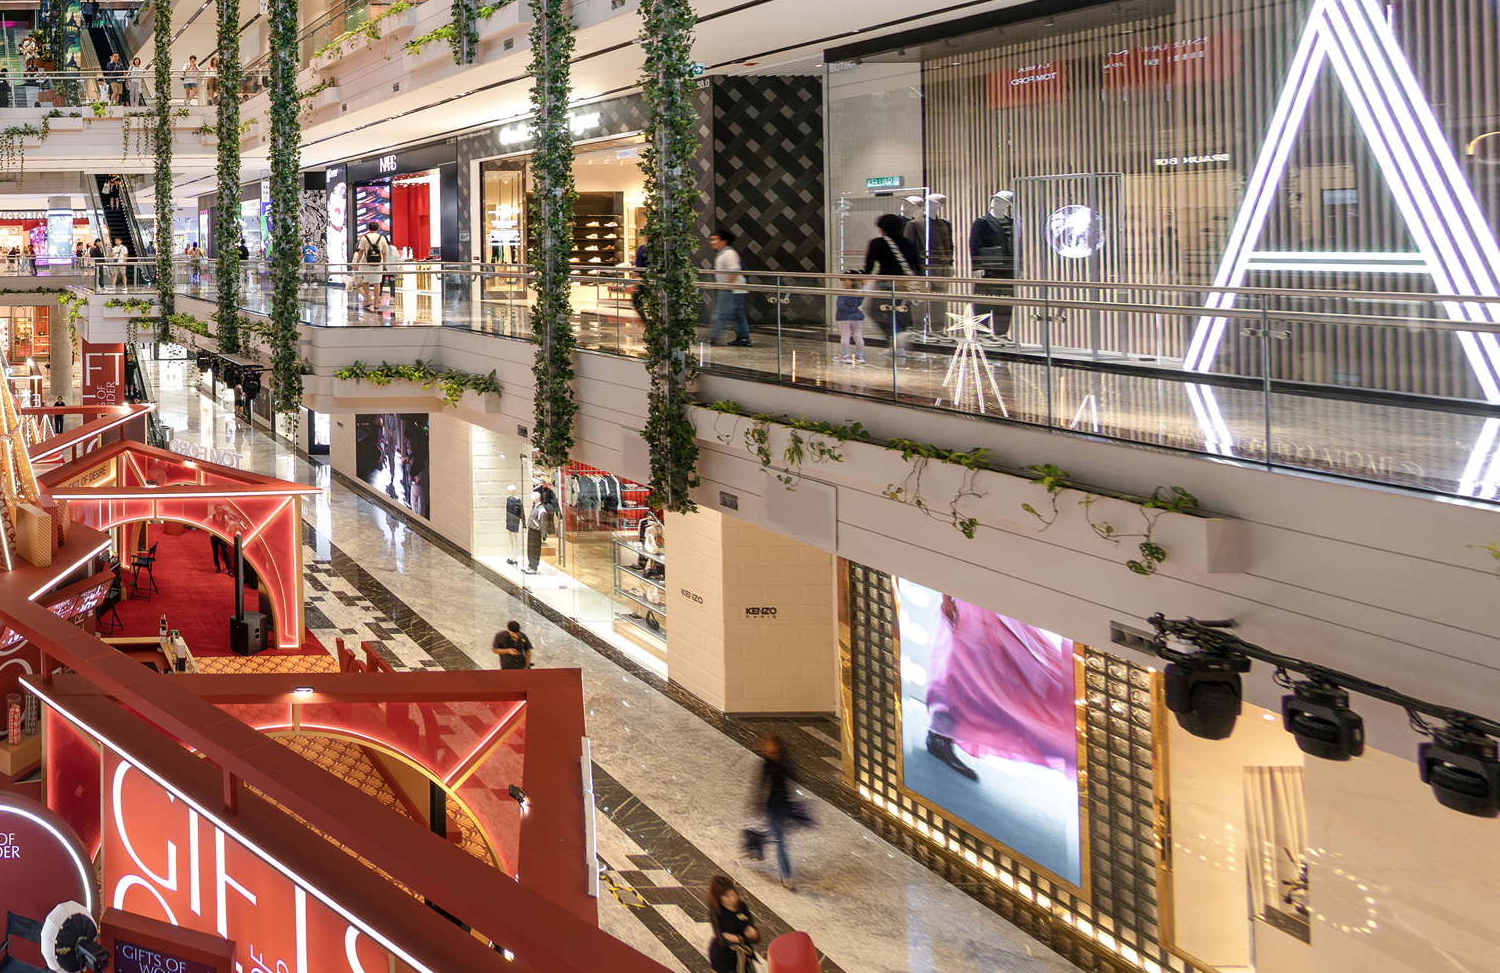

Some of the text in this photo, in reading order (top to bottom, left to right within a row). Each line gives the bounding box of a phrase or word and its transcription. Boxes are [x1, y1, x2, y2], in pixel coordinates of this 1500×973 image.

[379, 154, 397, 173] NARS
[866, 176, 893, 188] KELUAR
[81, 474, 88, 486] OF
[89, 465, 106, 482] DESIRE
[745, 607, 777, 615] KENZO
[122, 945, 161, 967] GIFTS
[166, 958, 187, 972] OF
